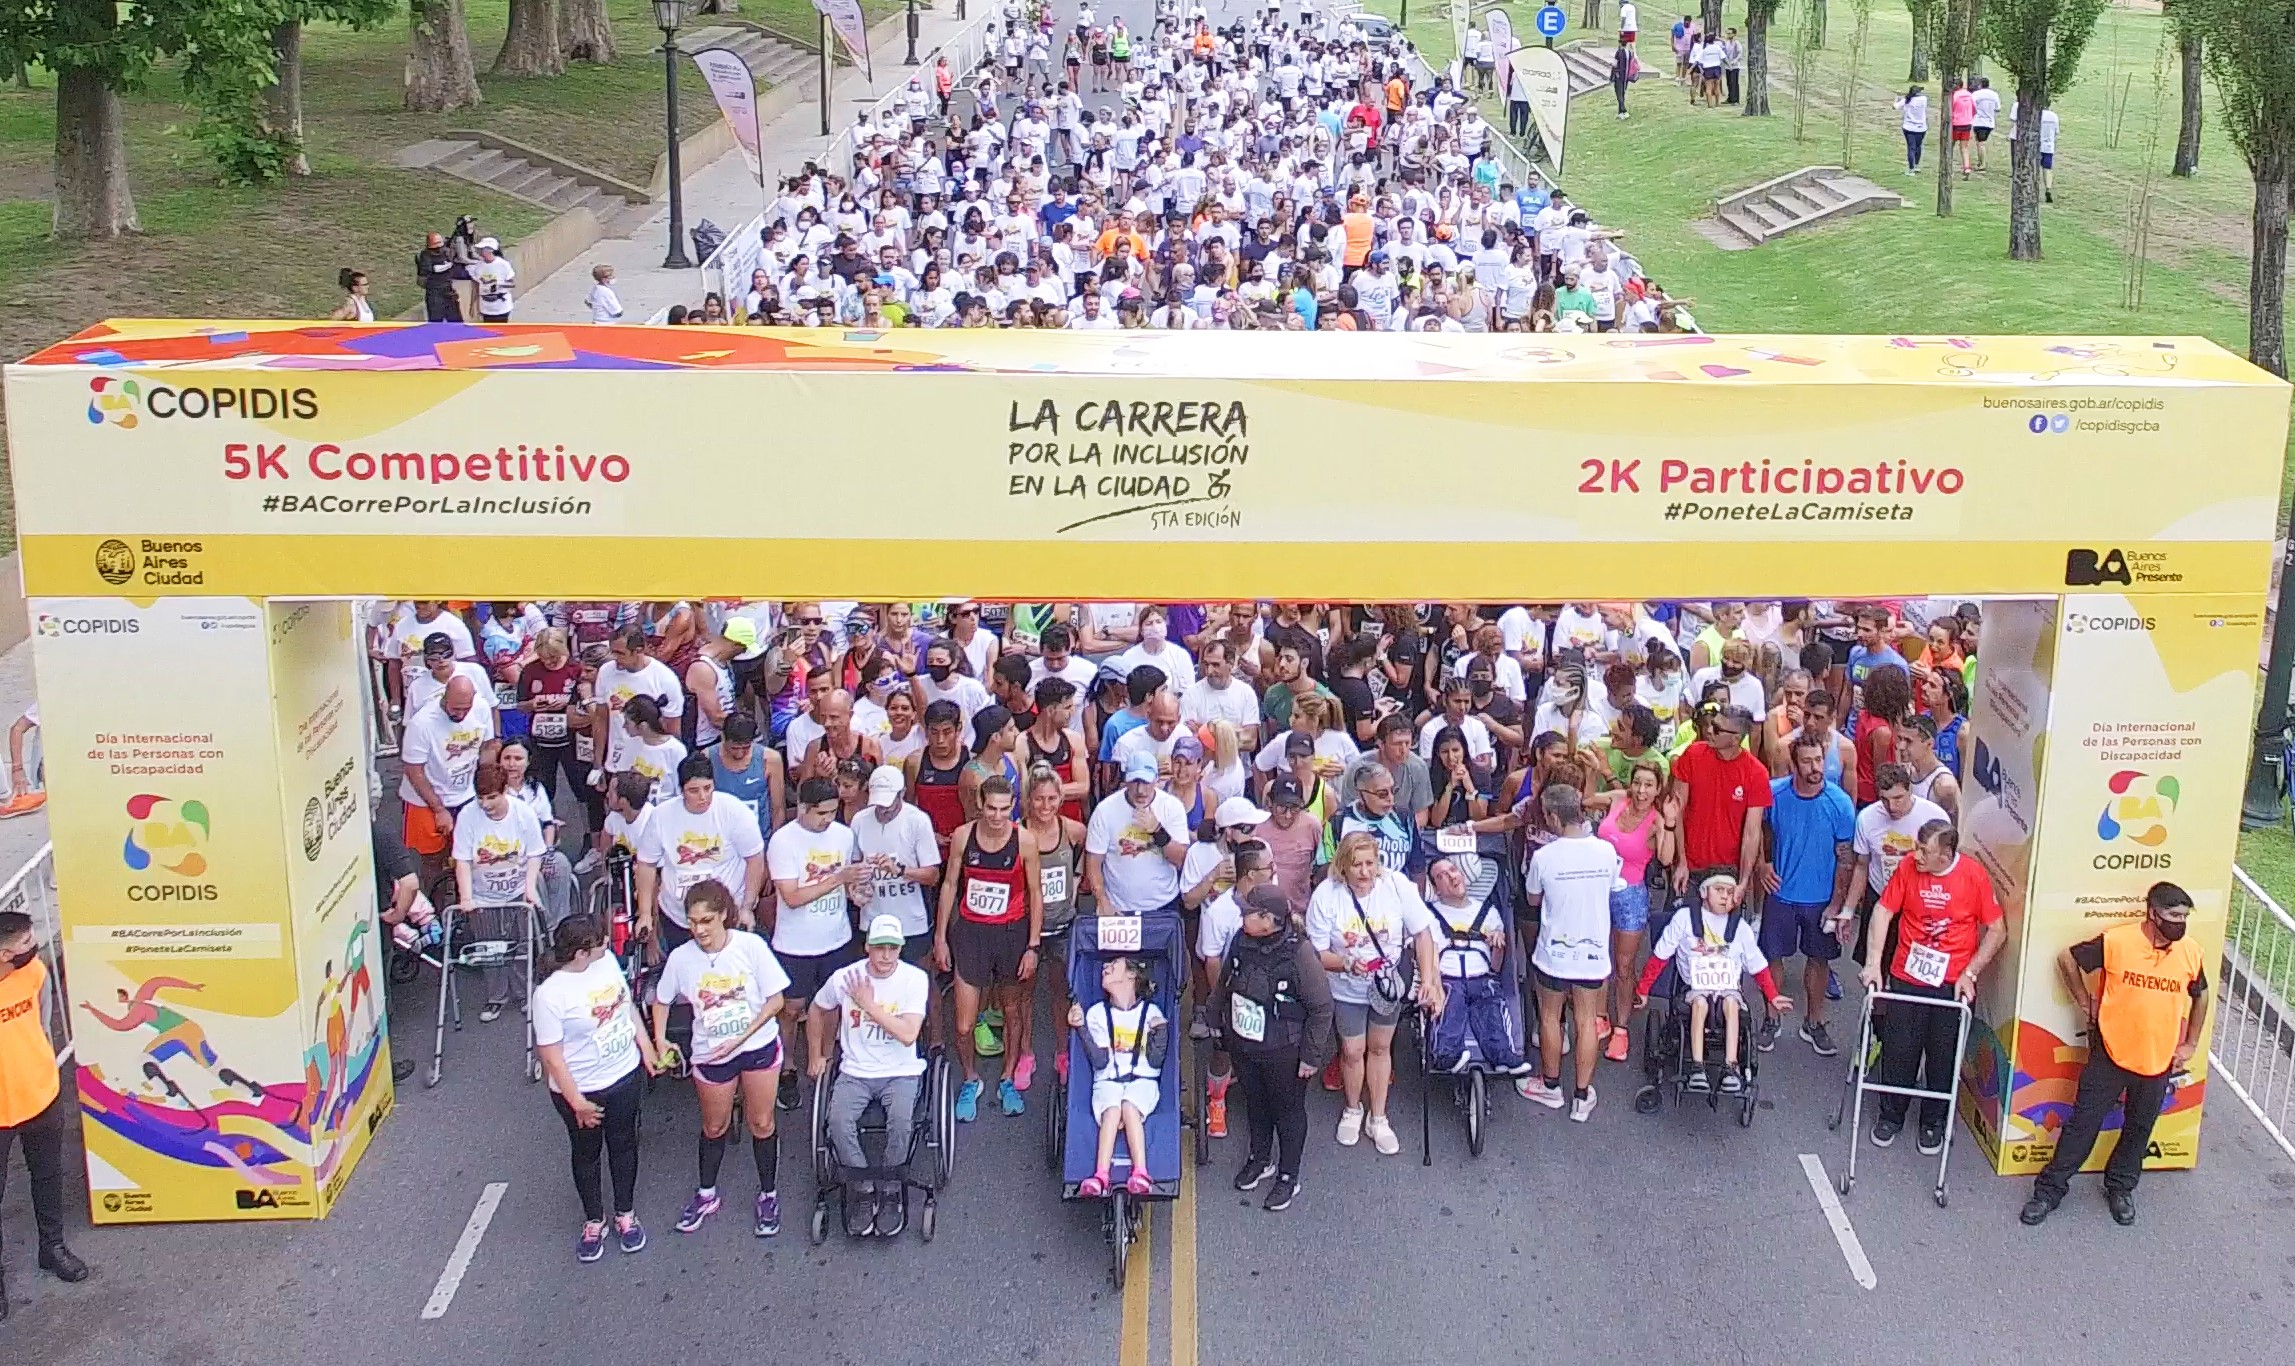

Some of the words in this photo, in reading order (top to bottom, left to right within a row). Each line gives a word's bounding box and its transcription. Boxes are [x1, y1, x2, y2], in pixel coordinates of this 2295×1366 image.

[1544, 12, 1558, 31] E
[147, 387, 319, 420] COPIDIS
[1983, 396, 2165, 413] buenosaires.gob.ar/copidis
[1009, 399, 1060, 436] LA
[1075, 399, 1249, 437] CARRERA
[2075, 419, 2161, 434] /copidisgcba
[1009, 442, 1061, 466] POR
[1068, 442, 1101, 466] LA
[1113, 434, 1249, 466] INCLUSIÓN
[224, 443, 289, 480] 5K
[308, 443, 631, 484] Competitivo
[1578, 459, 1642, 494] 2K
[1660, 458, 1964, 494] Participativo
[1009, 475, 1044, 496] EN
[1054, 475, 1086, 499] LA
[1097, 475, 1190, 498] CIUDAD
[262, 494, 592, 515] #BACorrePorLaInclusión
[1664, 502, 1914, 521] #PoneteLaCamiseta
[1151, 510, 1179, 530] 5TA
[1185, 506, 1241, 527] EDICIÓN
[141, 540, 203, 553] Buenos
[142, 556, 188, 569] Aires
[2127, 550, 2168, 562] Buenos
[2131, 562, 2161, 572] Aires
[144, 570, 204, 585] Ciudad
[2136, 572, 2184, 583] Presente
[63, 619, 140, 634] COPIDIS
[2089, 617, 2157, 631] COPIDIS
[2093, 721, 2114, 733] Día
[2117, 721, 2196, 733] Internacional
[95, 732, 118, 745] Día
[122, 732, 213, 745] Internacional
[2082, 736, 2099, 748] de
[2102, 736, 2119, 748] las
[2122, 736, 2177, 748] Personas
[2181, 737, 2202, 747] con
[87, 749, 105, 760] de
[109, 749, 129, 760] las
[133, 748, 195, 760] Personas
[199, 749, 224, 760] con
[2100, 750, 2182, 762] Discapacidad
[111, 764, 204, 777] Discapacidad
[2093, 854, 2172, 871] COPIDIS
[127, 884, 218, 902] COPIDIS
[1041, 879, 1065, 898] 080
[970, 891, 1005, 912] 5077
[1101, 929, 1139, 944] 1002
[1909, 953, 1941, 981] 7104
[1695, 971, 1731, 986] 1000
[2122, 970, 2182, 993] PREVENCION
[1236, 1011, 1263, 1034] 000
